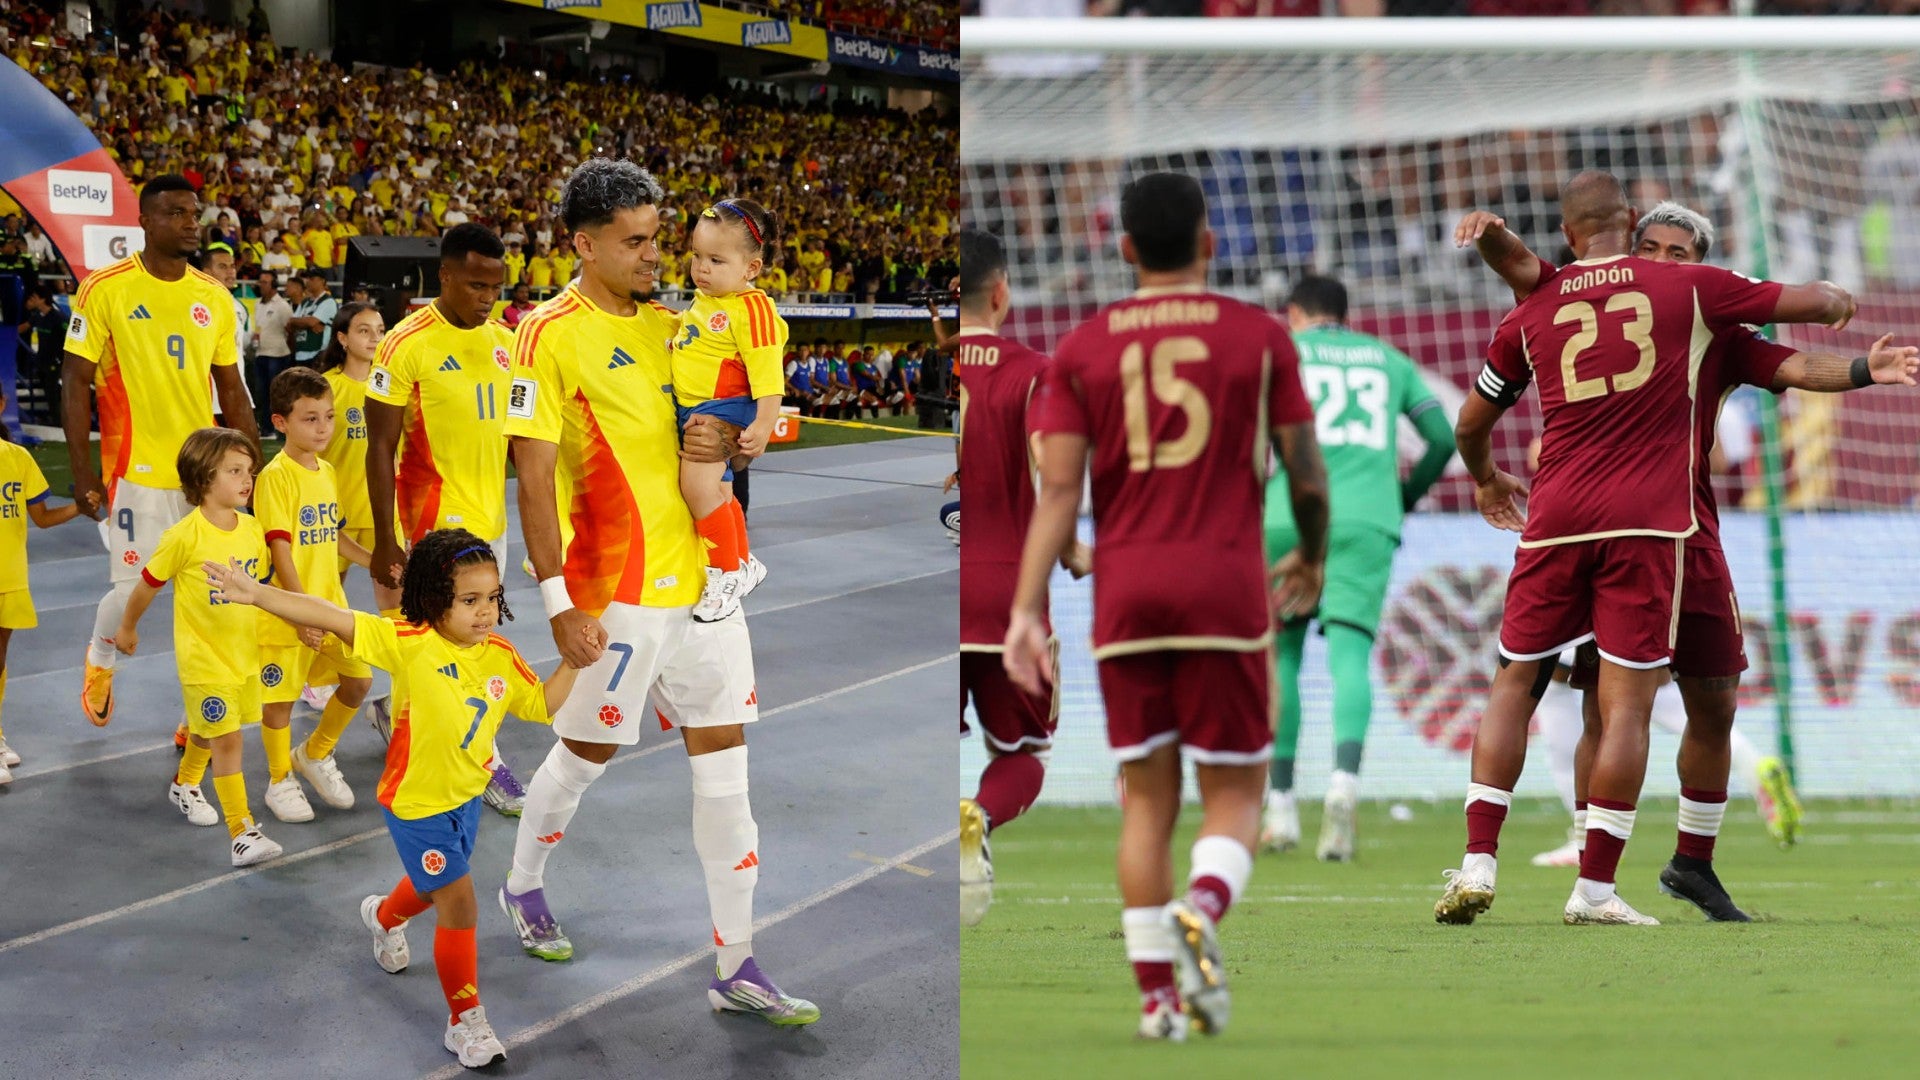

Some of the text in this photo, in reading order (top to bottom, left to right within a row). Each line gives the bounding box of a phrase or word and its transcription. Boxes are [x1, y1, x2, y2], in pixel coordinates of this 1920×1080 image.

[835, 36, 888, 64] BetPlay
[53, 184, 108, 203] BetPlay
[109, 235, 128, 260] G
[1560, 265, 1635, 295] RONDÓN
[167, 334, 185, 370] 9
[960, 343, 1000, 366] INO
[1552, 291, 1657, 403] 23
[476, 382, 495, 420] 11
[1120, 335, 1213, 473] 15
[1303, 364, 1390, 450] 23
[774, 417, 788, 438] G
[0, 481, 22, 502] CF
[118, 507, 135, 542] 9
[607, 642, 634, 692] 7
[461, 697, 489, 749] 7
